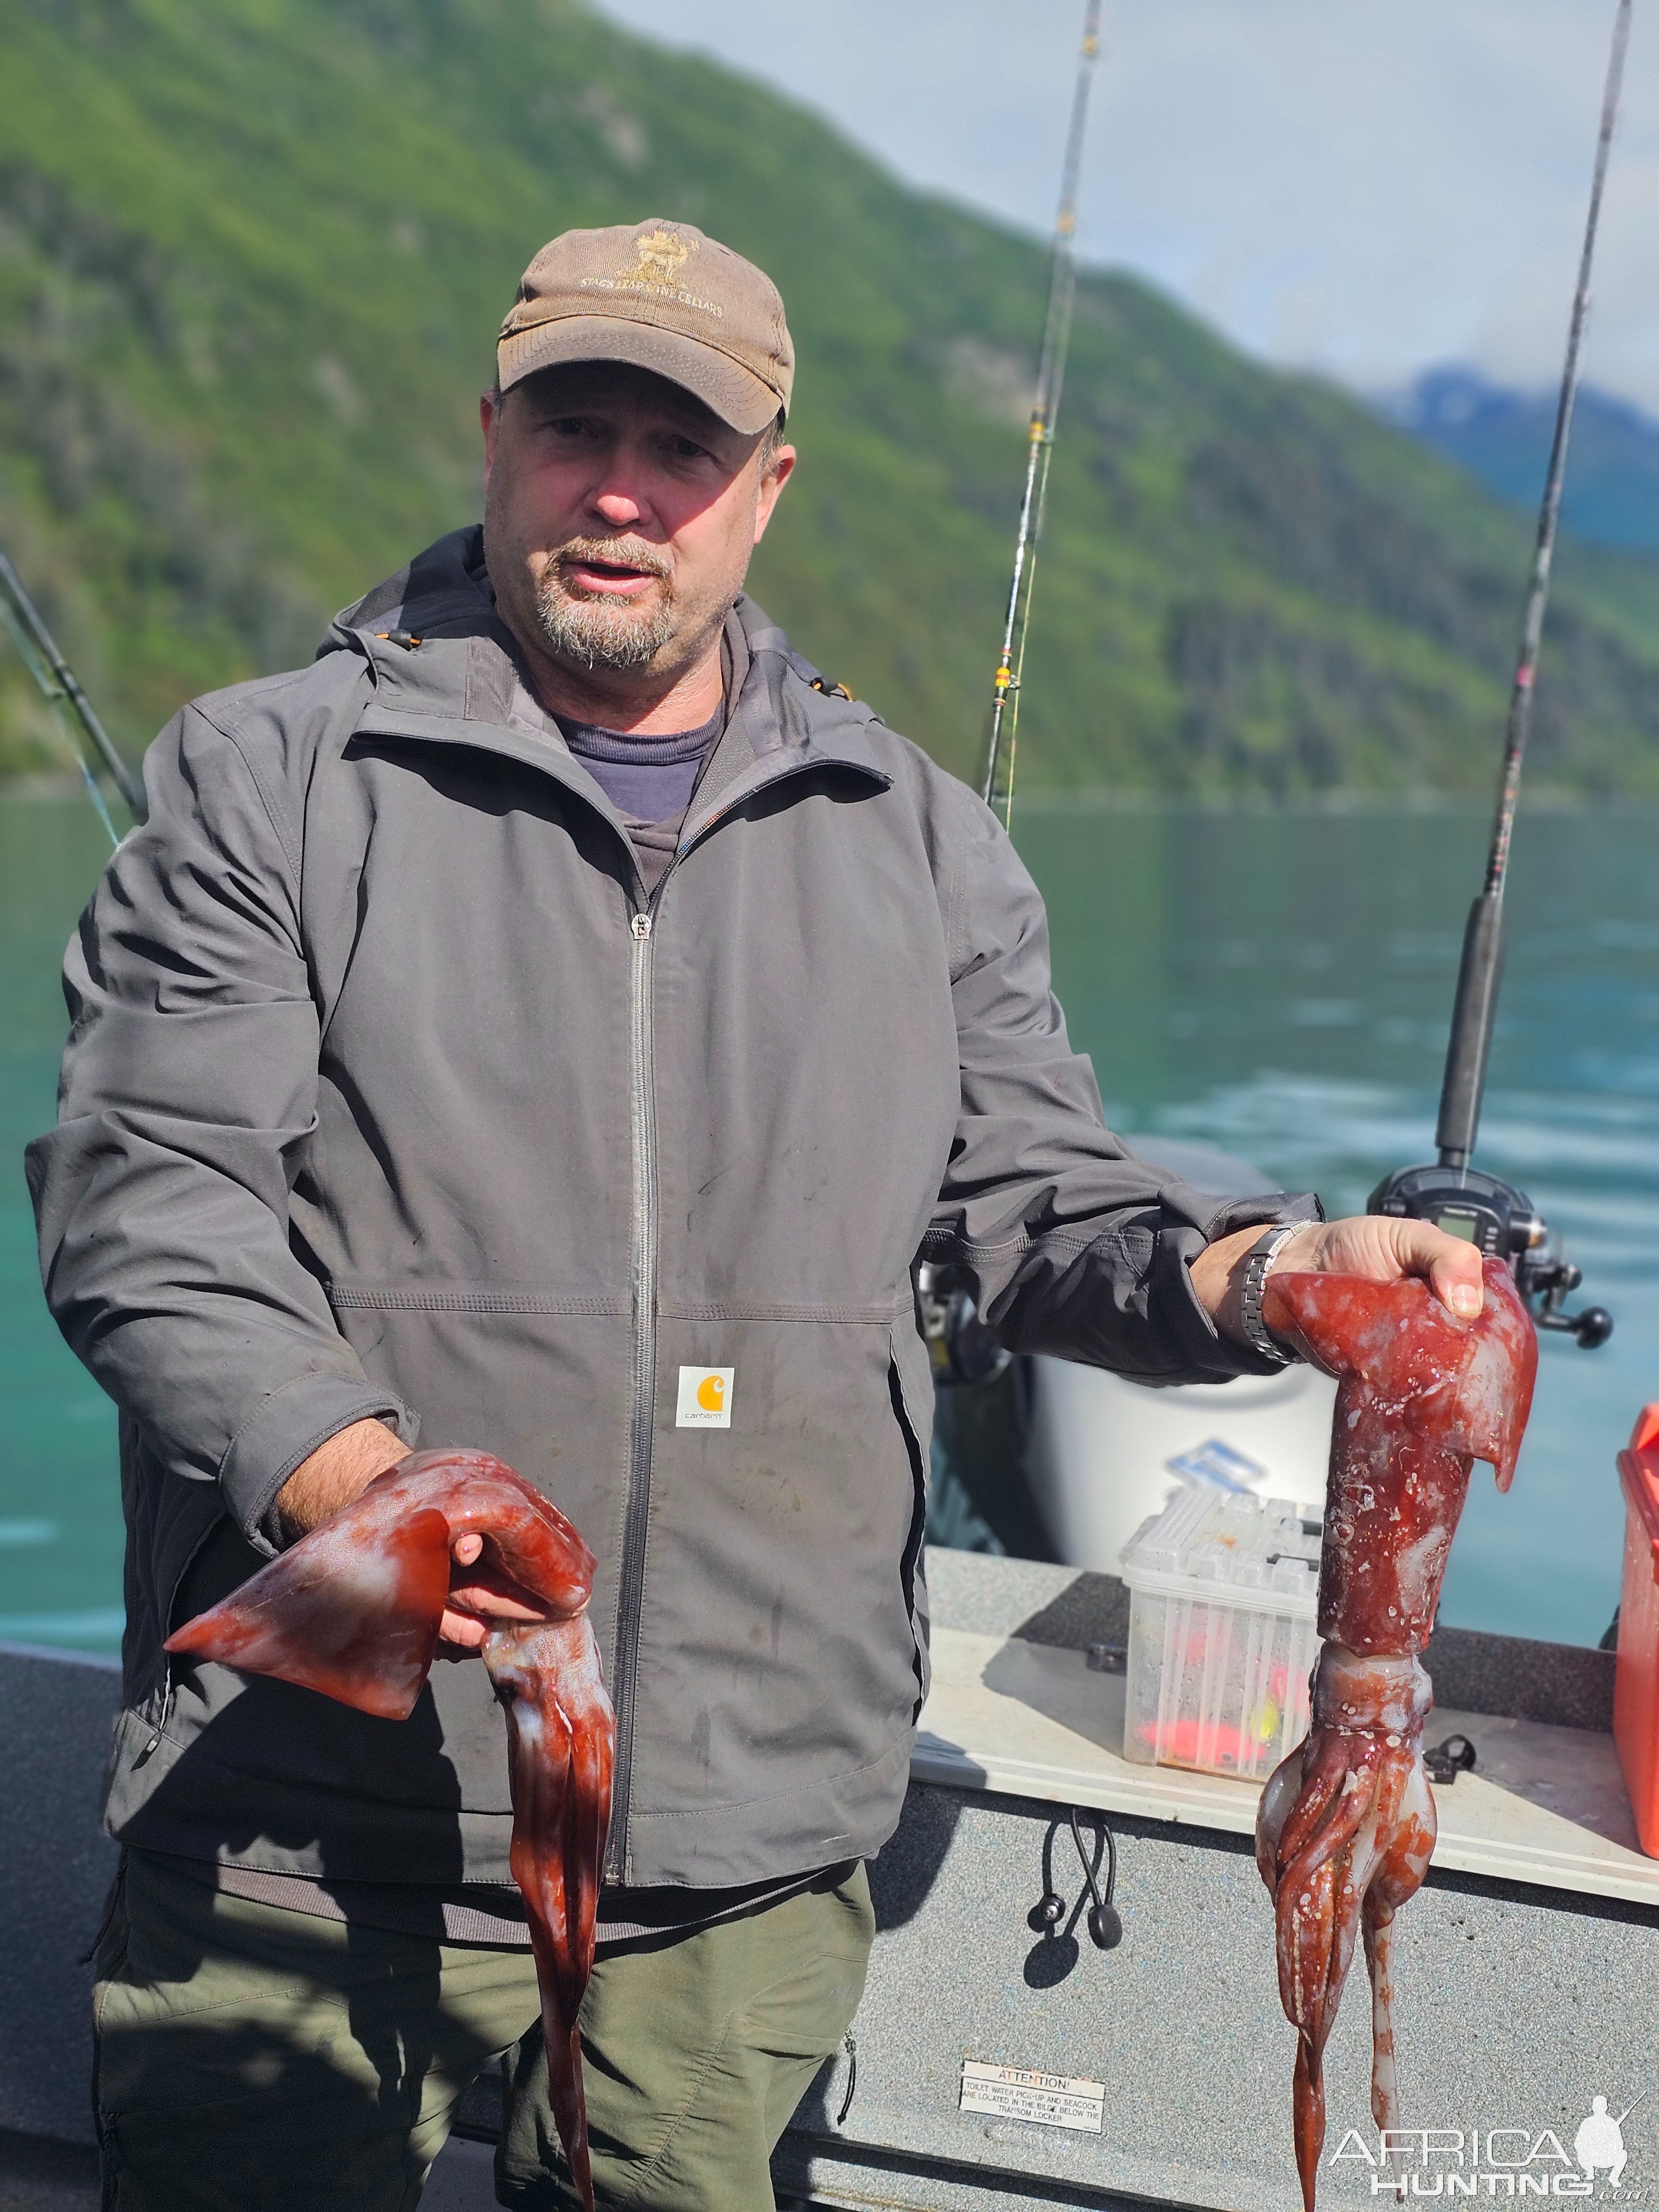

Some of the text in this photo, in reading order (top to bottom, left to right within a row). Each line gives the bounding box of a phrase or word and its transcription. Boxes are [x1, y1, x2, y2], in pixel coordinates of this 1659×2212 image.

[679, 291, 723, 317] CELLARS
[999, 2070, 1070, 2090] ATTENTION!
[963, 2090, 976, 2099] ARE
[978, 2093, 1009, 2104] LOCATED
[1021, 2100, 1034, 2109] THE
[1037, 2103, 1057, 2112] BILGE
[1060, 2107, 1084, 2117] BELOW
[1086, 2111, 1100, 2120] THE
[966, 2082, 1097, 2111] TOILET WATER PICK-UP AND SEACOCK
[998, 2105, 1062, 2122] TRANSOM LOCKER
